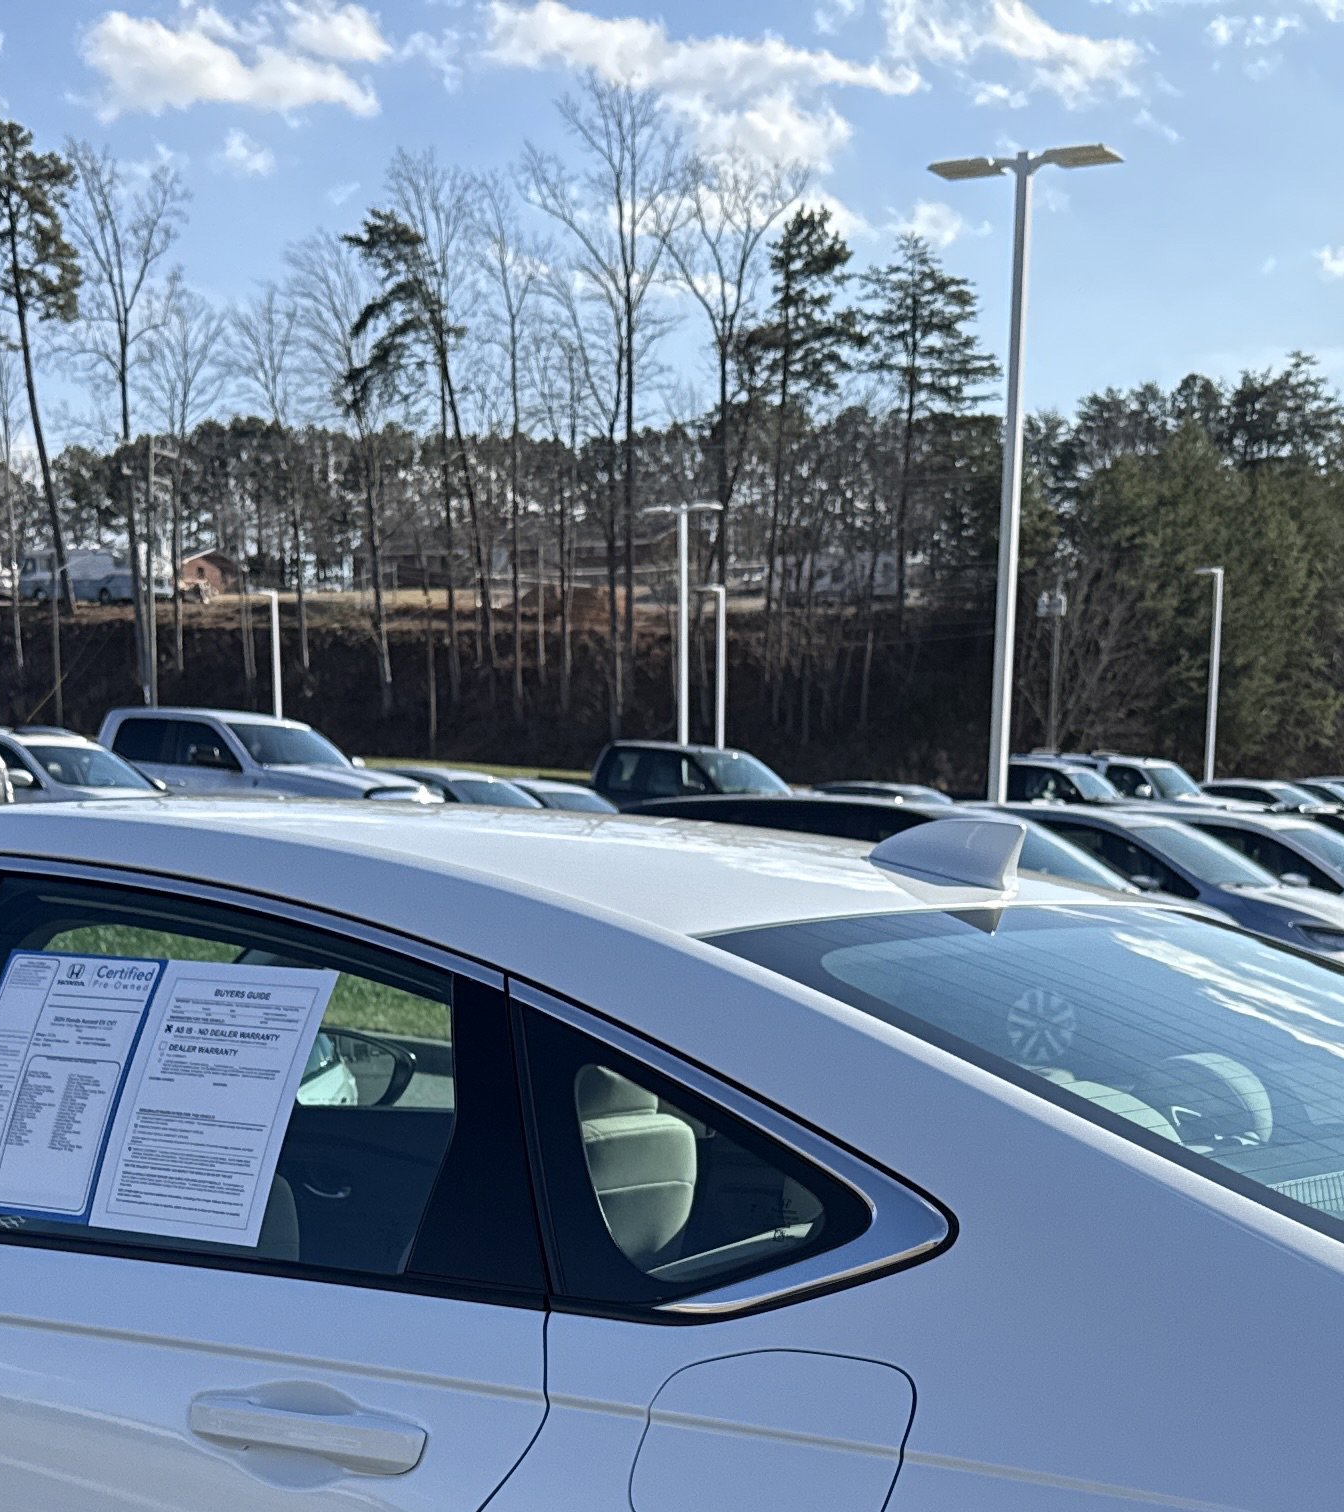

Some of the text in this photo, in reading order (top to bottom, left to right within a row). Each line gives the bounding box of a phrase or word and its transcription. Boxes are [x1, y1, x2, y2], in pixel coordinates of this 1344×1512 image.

[97, 965, 156, 981] Certified
[214, 989, 272, 1001] BUYERS GUIDE
[175, 1026, 185, 1034] AS
[185, 1026, 193, 1035] IS
[198, 1028, 209, 1036] NO
[209, 1028, 239, 1039] DEALER
[239, 1031, 280, 1041] WARRANTY
[168, 1043, 239, 1056] DEALER WARRANTY
